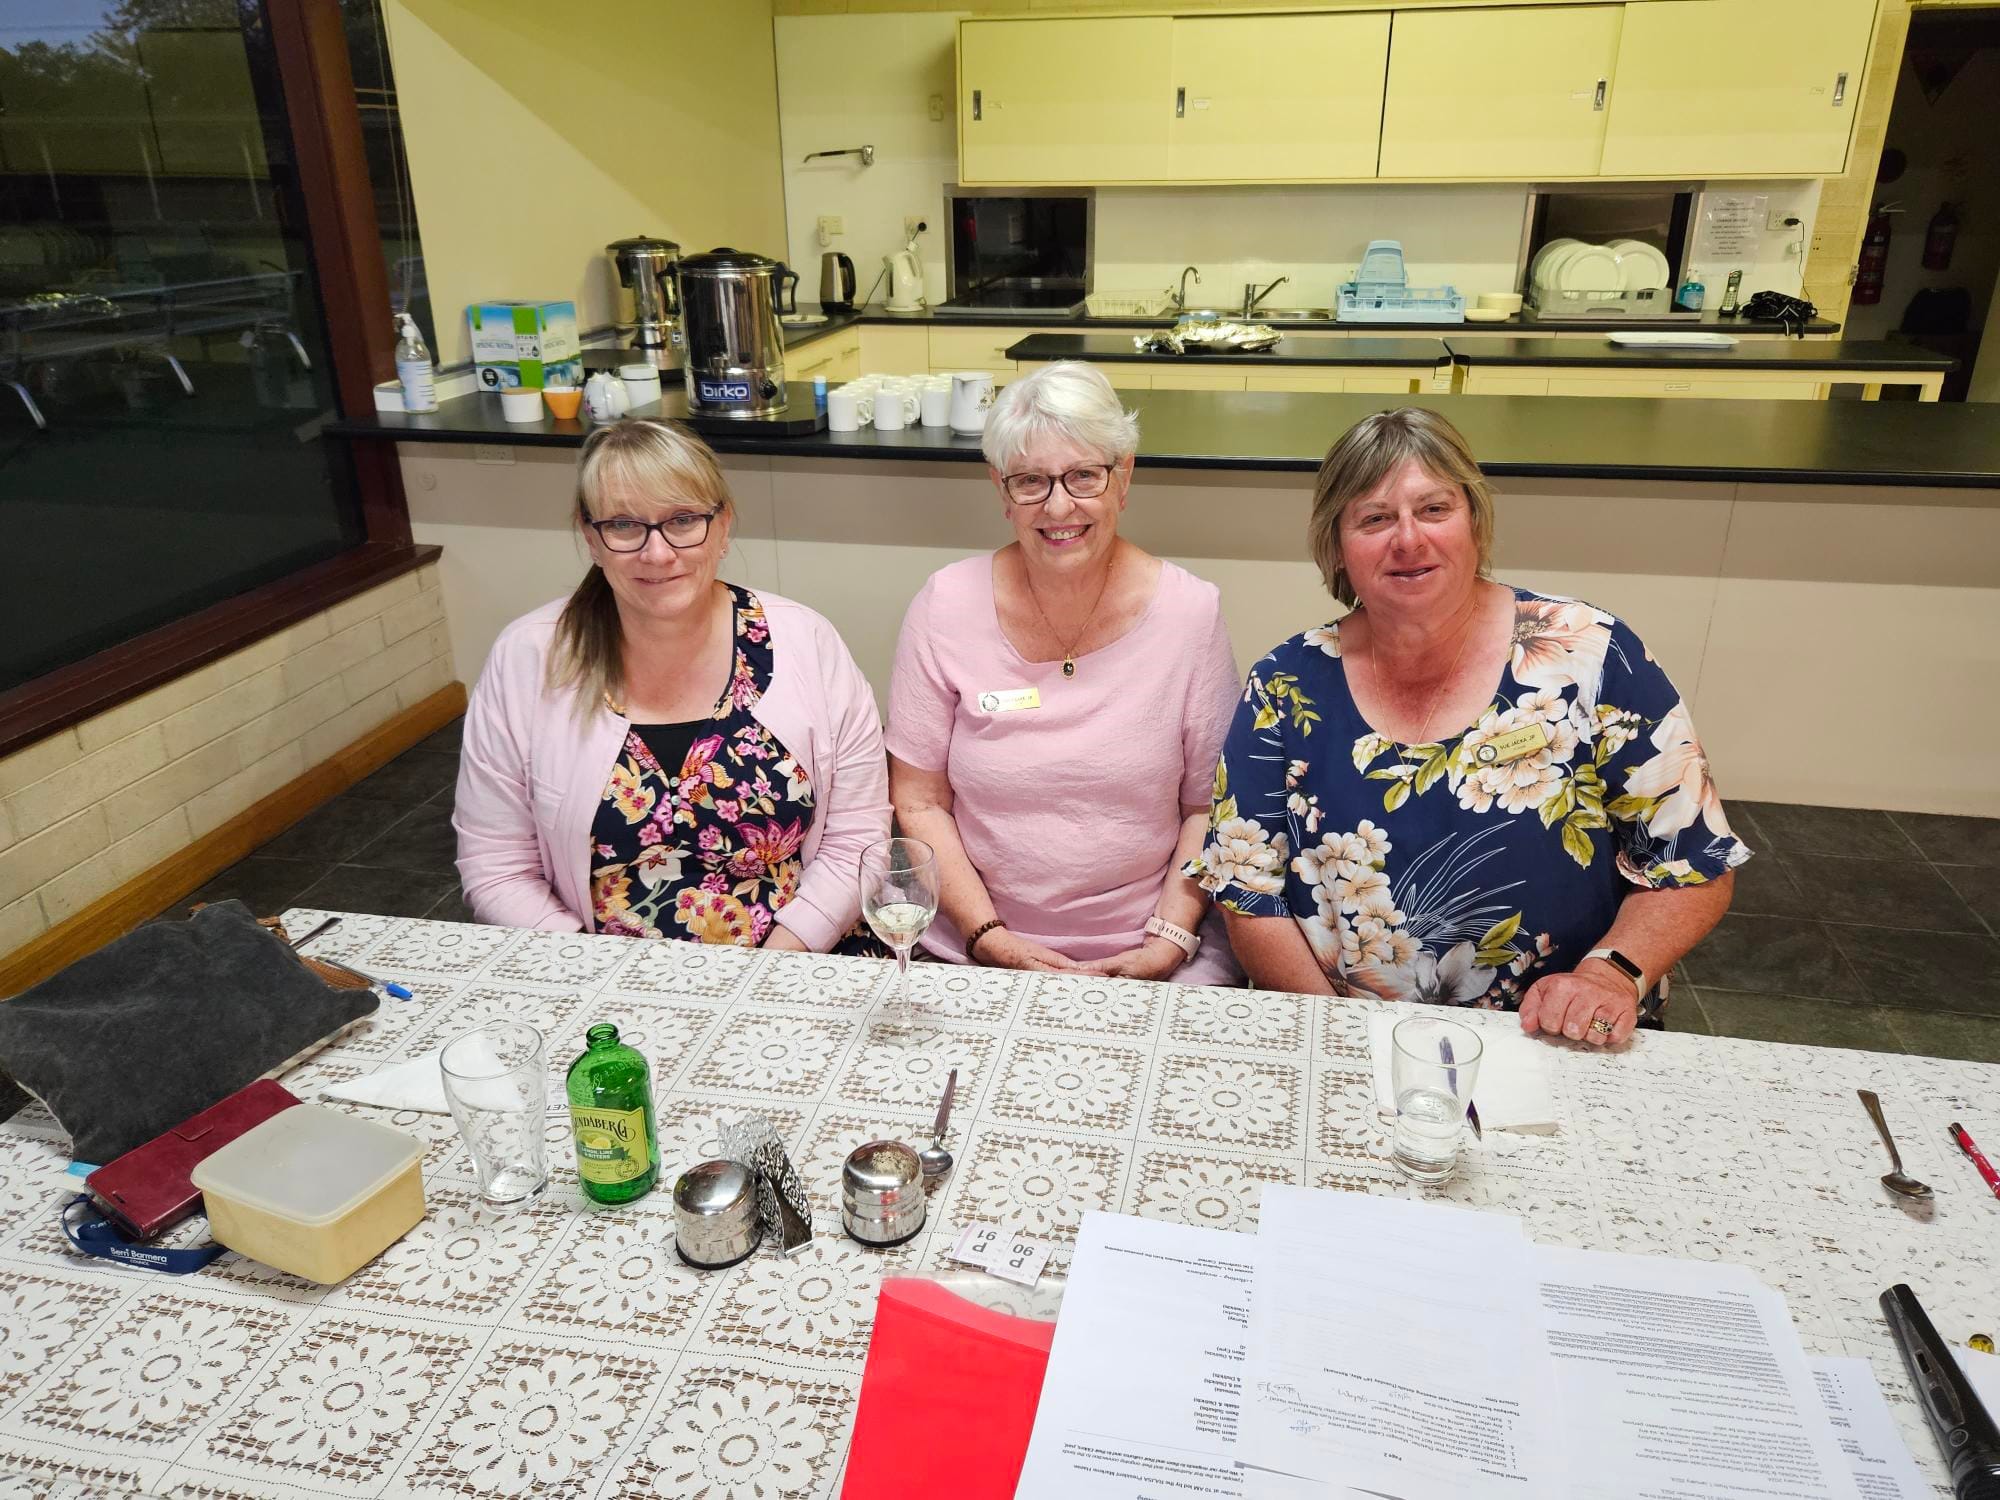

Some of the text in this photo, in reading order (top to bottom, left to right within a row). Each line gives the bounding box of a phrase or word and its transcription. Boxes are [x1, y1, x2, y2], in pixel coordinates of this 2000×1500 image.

[703, 384, 748, 398] birko
[1512, 738, 1528, 748] JACKA
[977, 1229, 998, 1242] 91
[972, 1242, 988, 1253] P
[1012, 1244, 1035, 1256] 90
[110, 1246, 168, 1262] Berri Barmera
[1008, 1258, 1024, 1268] P
